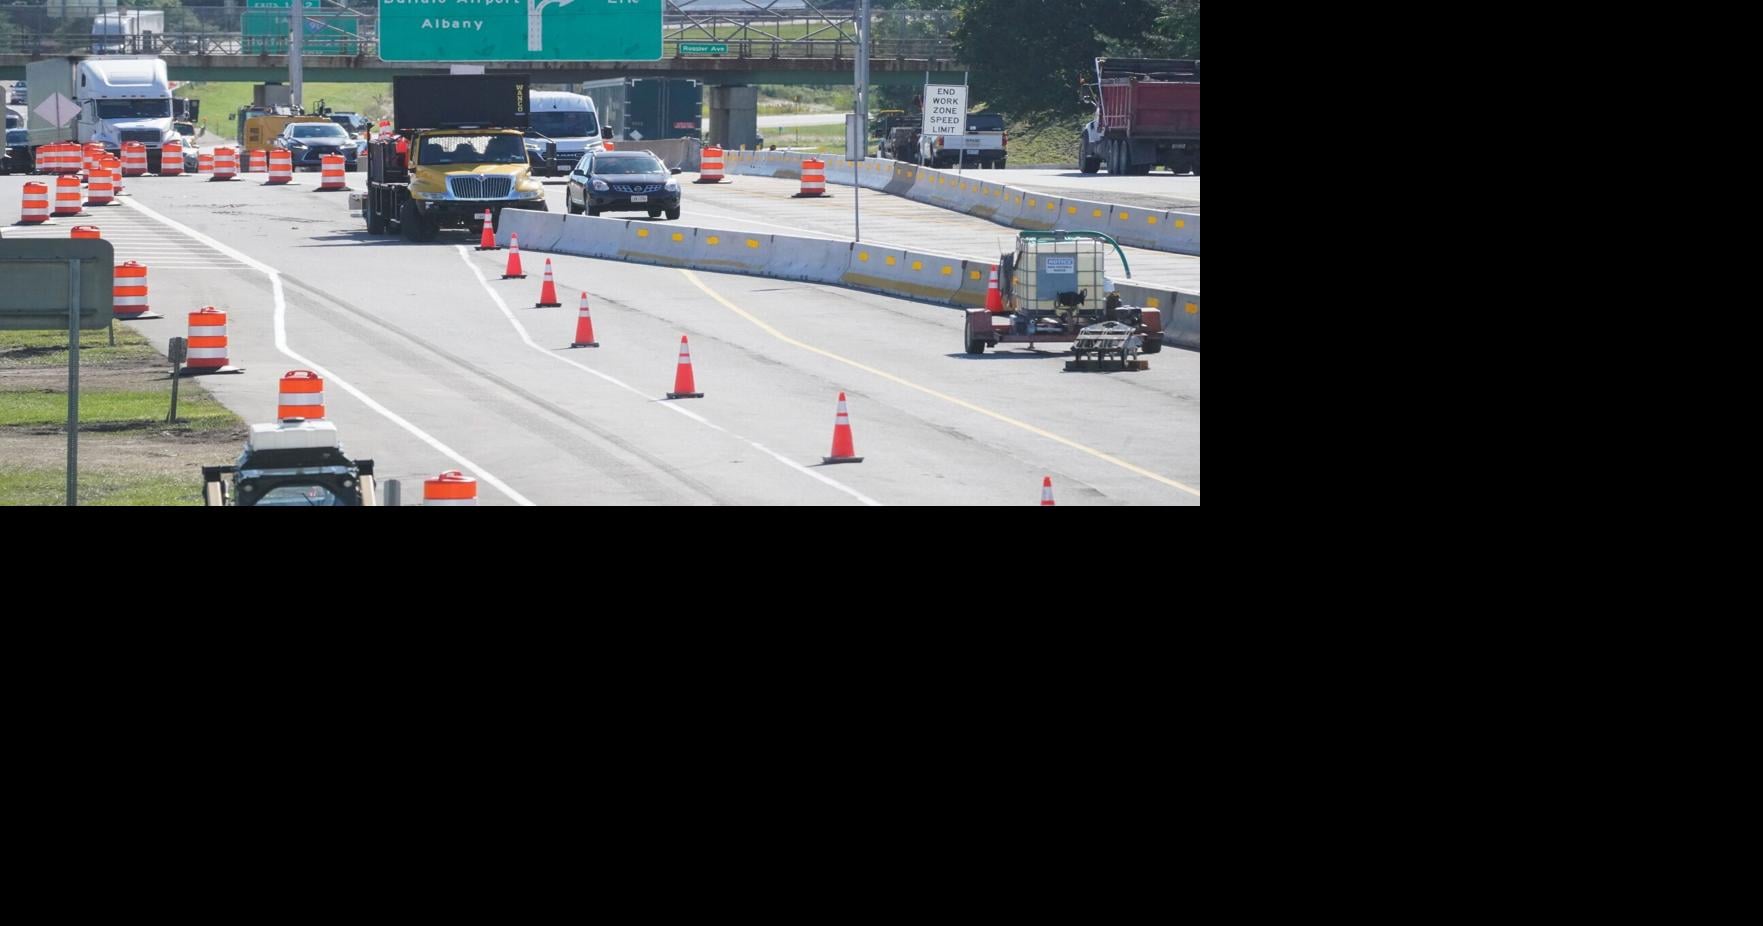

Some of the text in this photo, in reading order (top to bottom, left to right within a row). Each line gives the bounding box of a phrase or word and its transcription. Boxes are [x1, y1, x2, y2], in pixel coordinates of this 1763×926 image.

[421, 18, 483, 31] Albany
[937, 88, 956, 96] END
[932, 97, 959, 105] WORK
[933, 106, 958, 115] ZONE
[930, 116, 960, 124] SPEED
[932, 126, 956, 134] LIMIT
